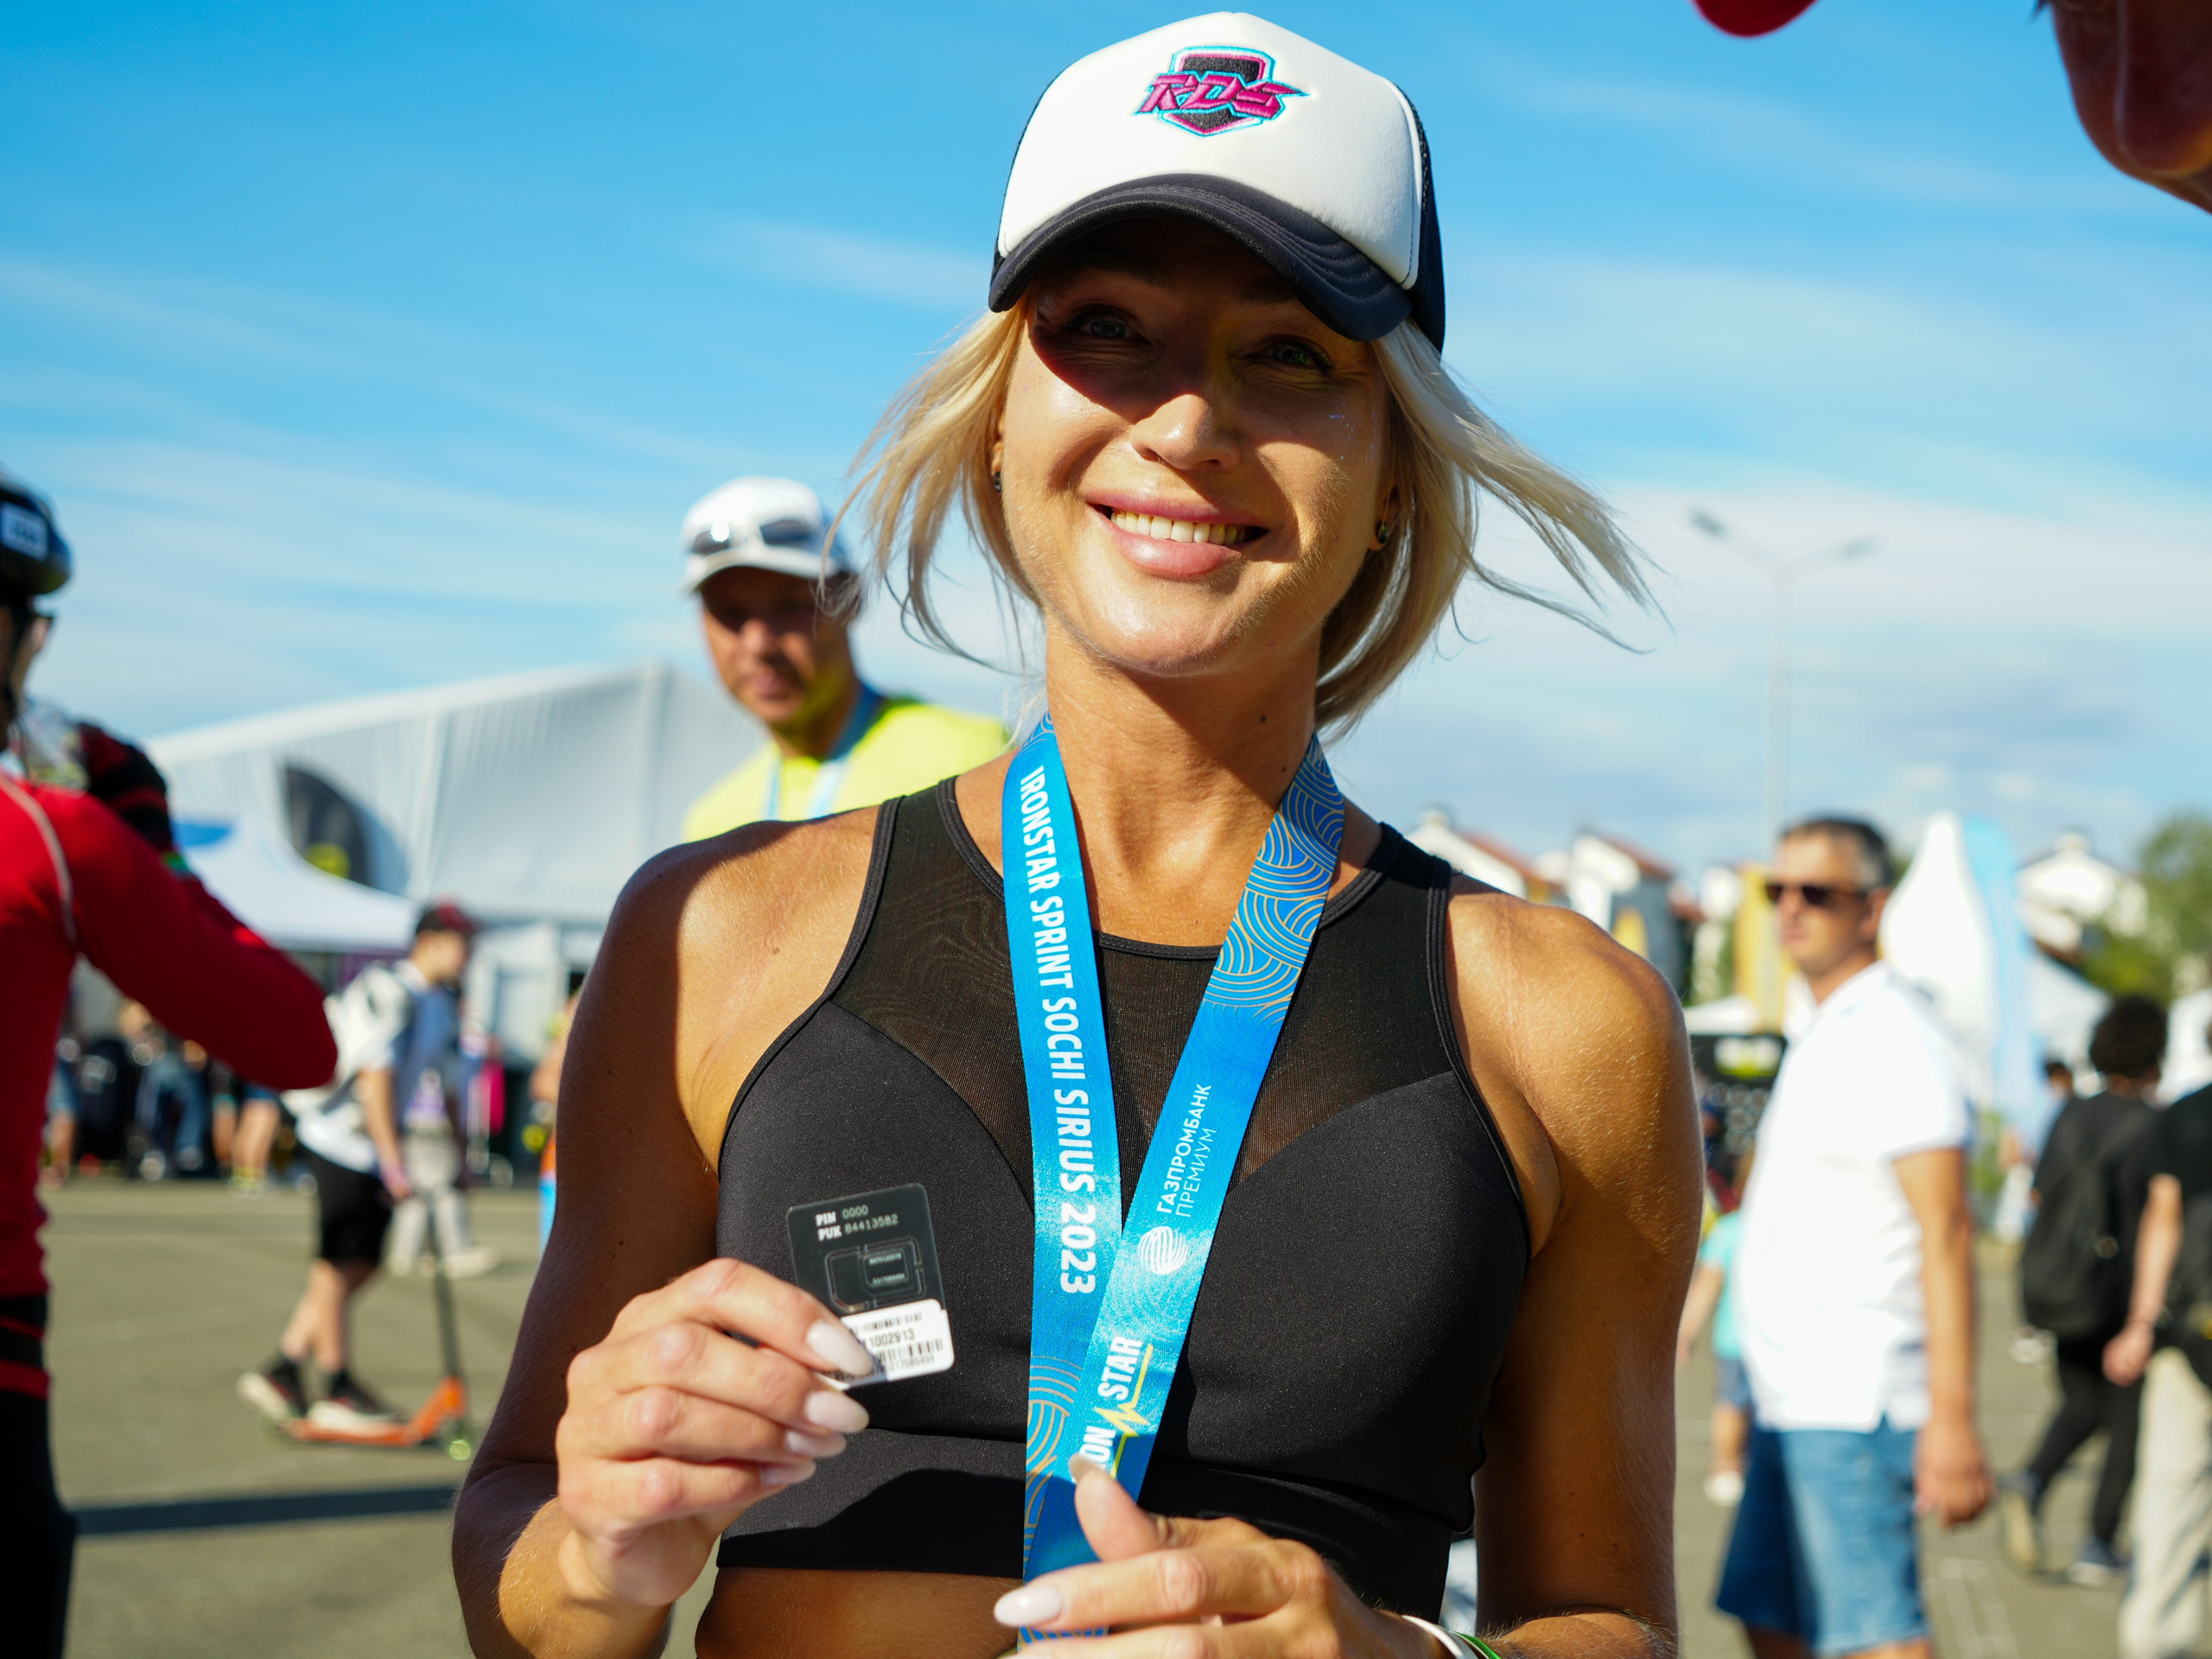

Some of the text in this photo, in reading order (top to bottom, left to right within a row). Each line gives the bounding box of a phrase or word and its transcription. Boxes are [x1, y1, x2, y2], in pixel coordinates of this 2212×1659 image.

[1134, 71, 1308, 120] RDS
[1020, 765, 1096, 1294] IRONSTAR SPRINT SOCHI SIRIUS 2023
[1157, 1084, 1212, 1214] ГАЗПРОМБАНК
[1176, 1128, 1217, 1217] ПРЕМИУМ
[816, 1205, 869, 1227] PIN 0000
[817, 1225, 842, 1242] PUK
[864, 1327, 916, 1348] 1002913
[1071, 1336, 1143, 1484] ON STAR
